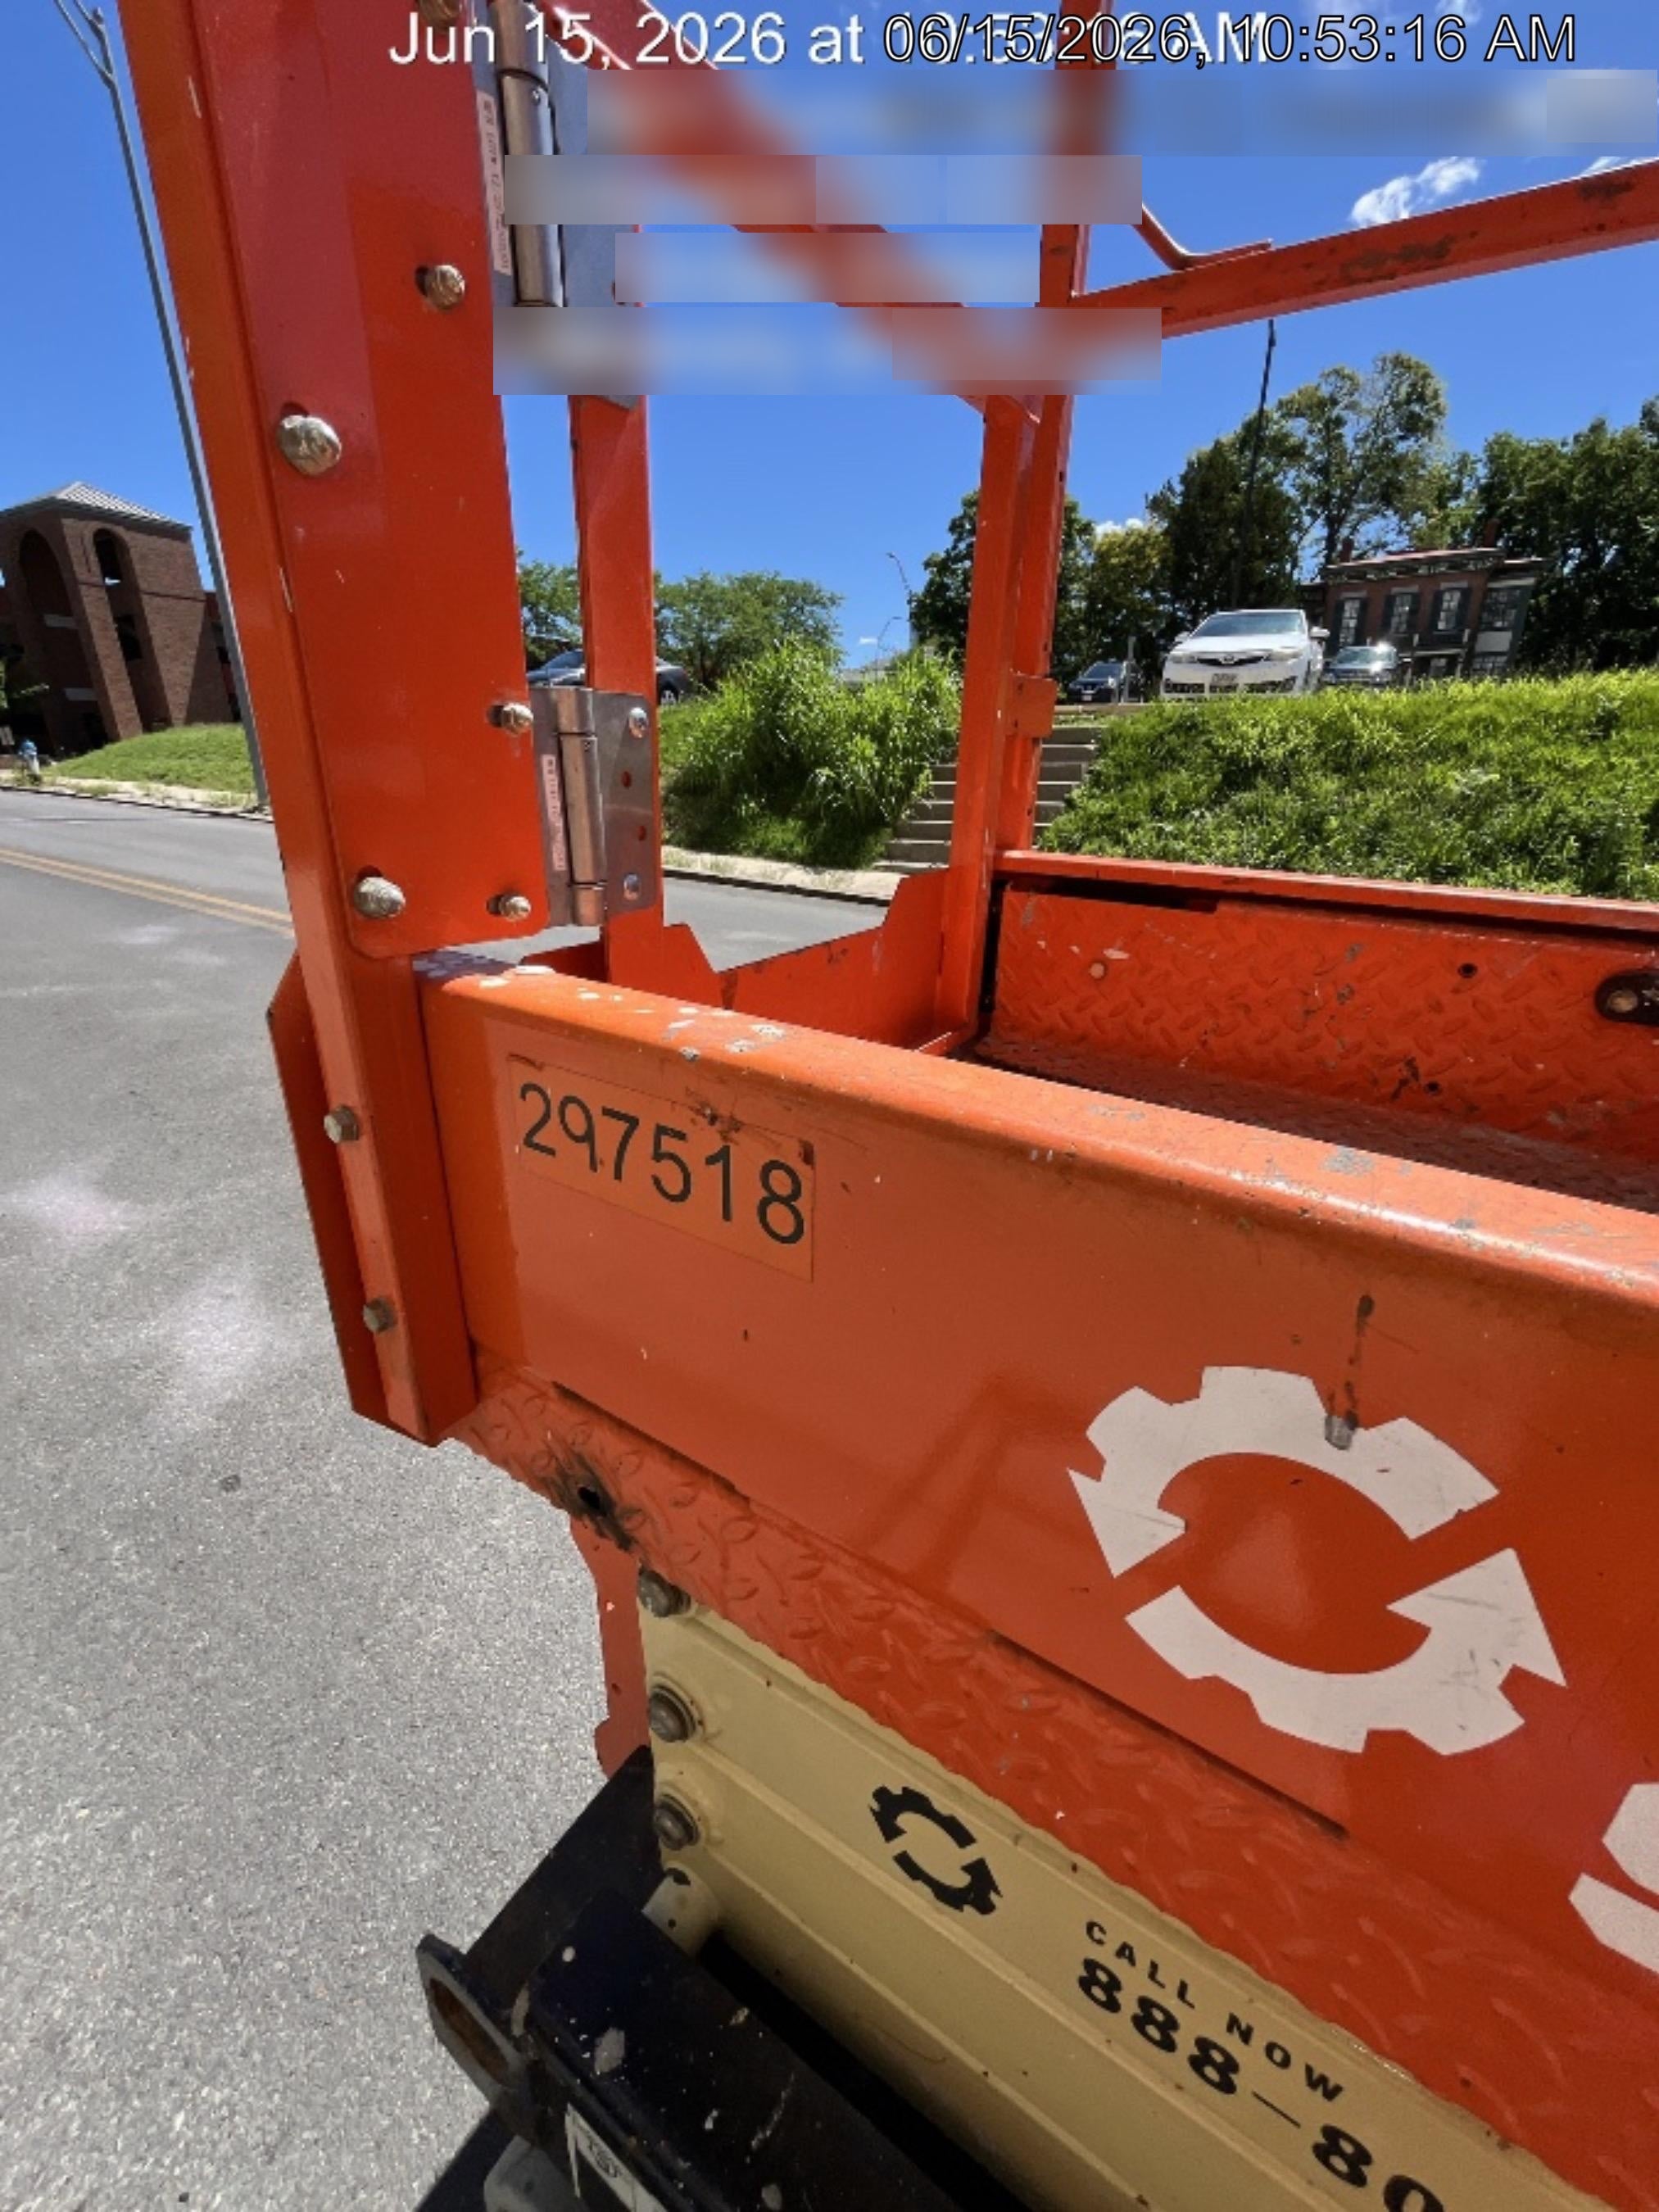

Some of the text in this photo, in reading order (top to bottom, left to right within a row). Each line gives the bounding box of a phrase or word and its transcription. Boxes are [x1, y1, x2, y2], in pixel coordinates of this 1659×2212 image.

[519, 1081, 805, 1244] 297518
[1086, 1920, 1344, 2102] CALL NOW
